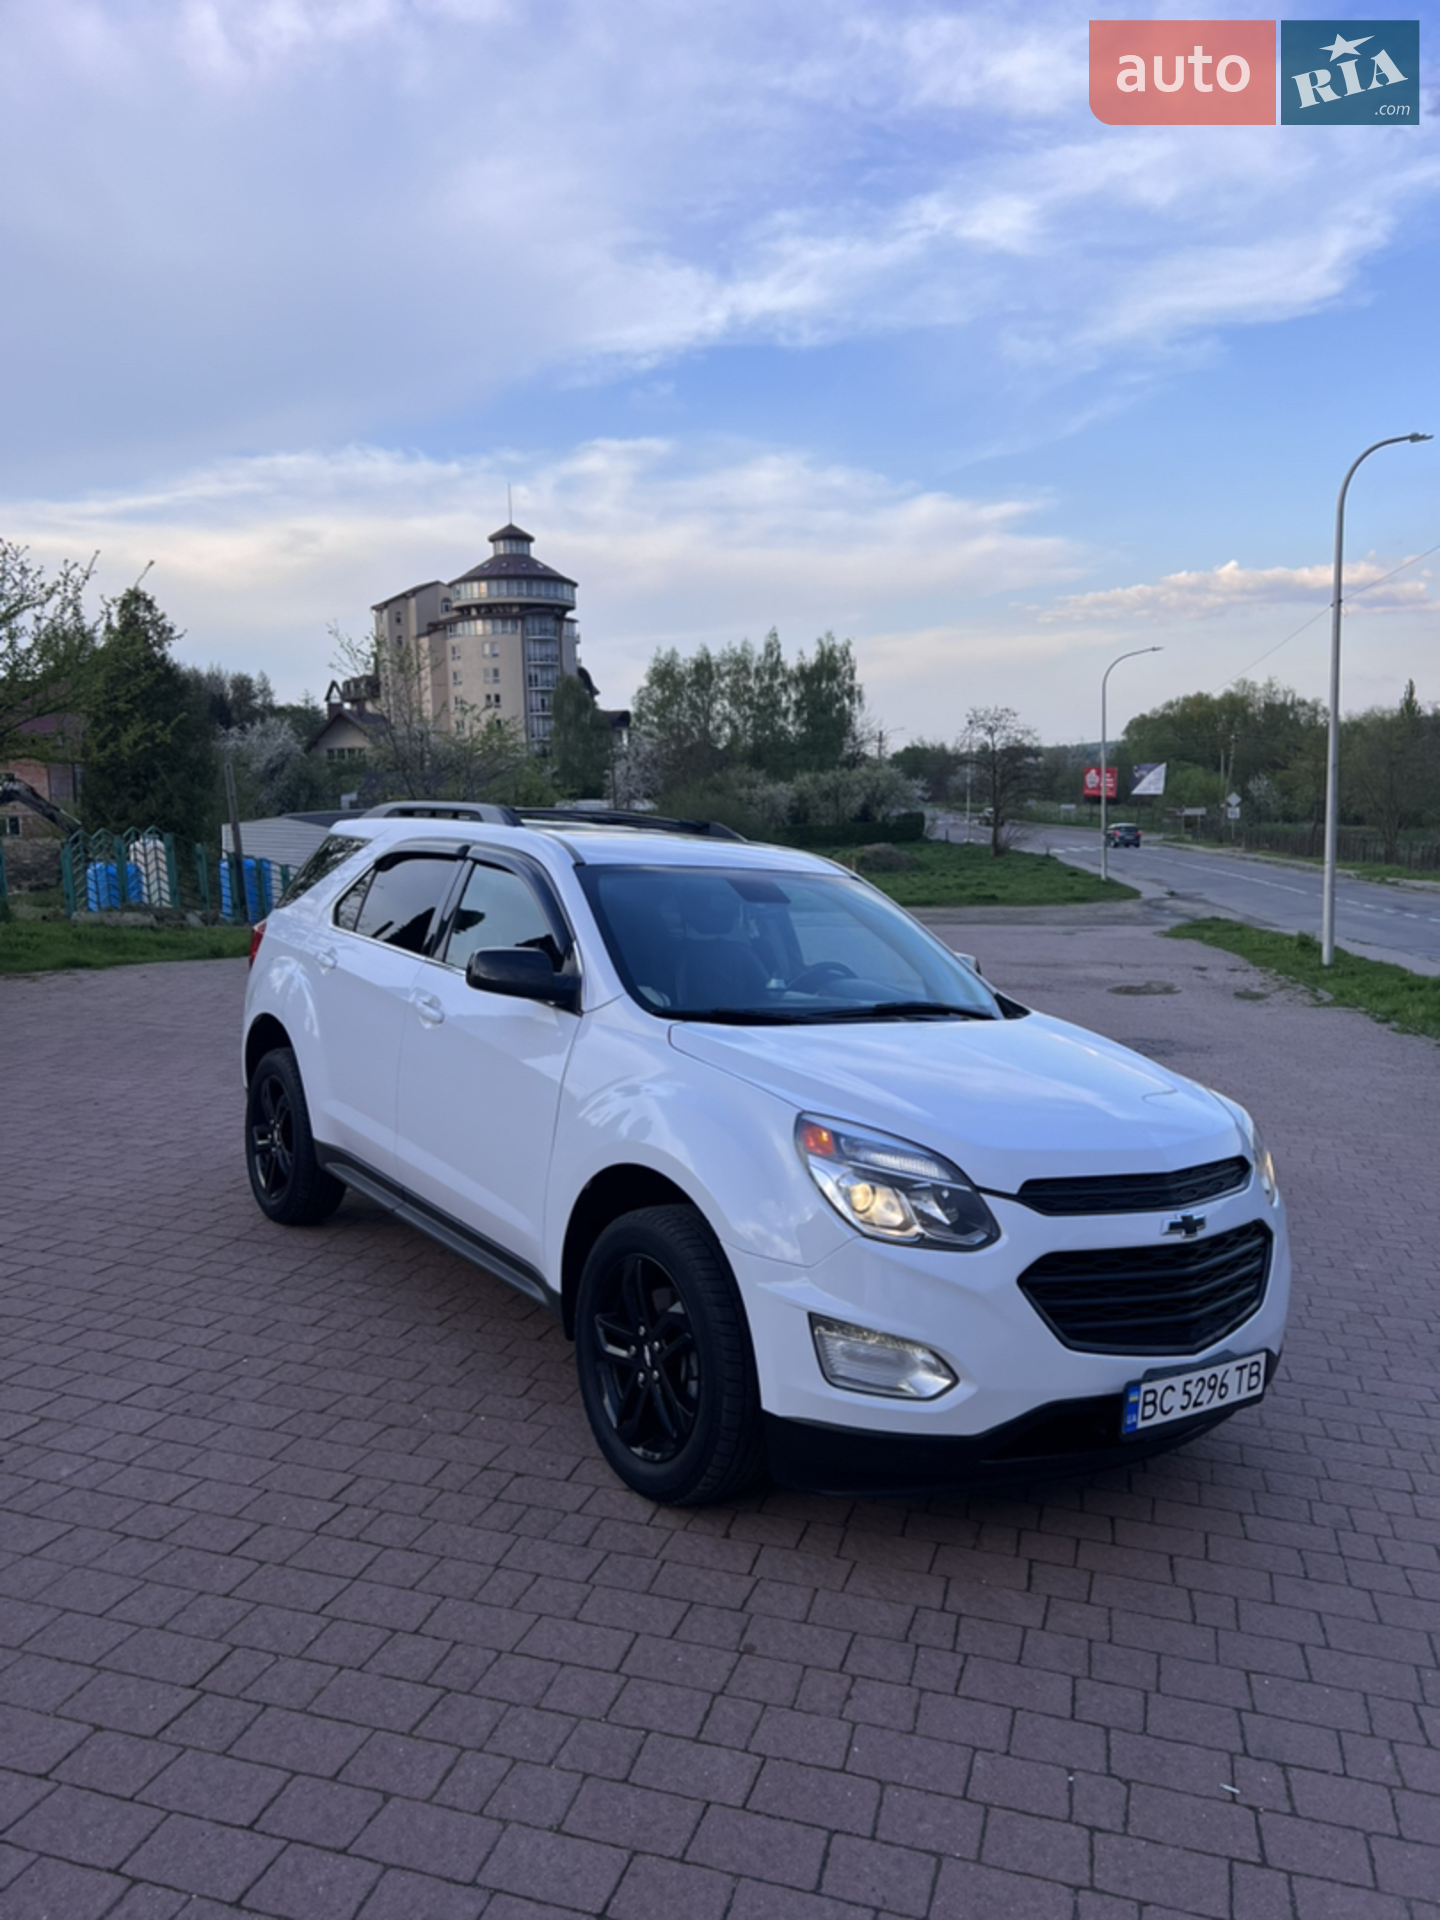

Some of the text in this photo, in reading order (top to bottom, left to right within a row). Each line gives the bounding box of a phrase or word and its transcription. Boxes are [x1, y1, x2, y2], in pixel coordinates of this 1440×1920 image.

[1141, 1361, 1261, 1421] BC 5296 TB
